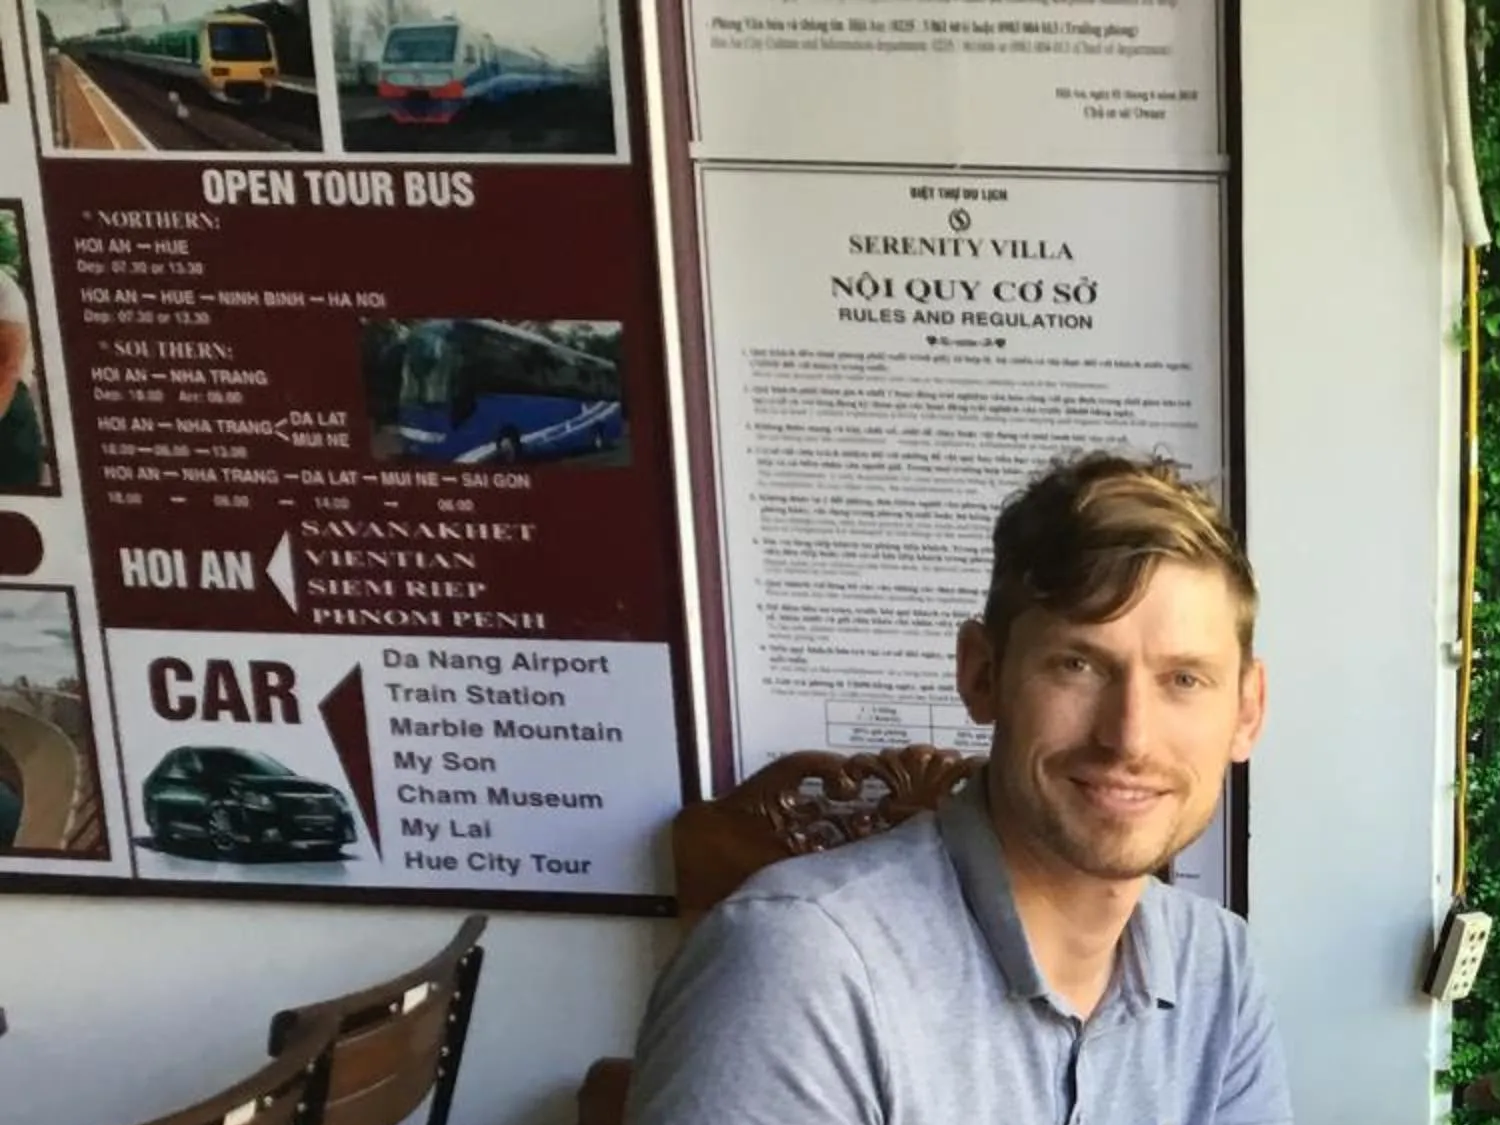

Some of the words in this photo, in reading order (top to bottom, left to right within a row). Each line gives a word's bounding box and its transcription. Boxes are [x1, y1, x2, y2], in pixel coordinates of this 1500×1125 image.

[202, 169, 296, 205] OPEN
[303, 170, 395, 206] TOUR
[405, 171, 475, 207] BUS
[97, 210, 221, 230] NORTHERN:
[75, 238, 103, 253] HOI
[108, 239, 131, 253] AN
[155, 240, 189, 255] HUE
[848, 235, 984, 257] SERENITY
[990, 239, 1074, 261] VILLA
[81, 288, 109, 303] HOI
[115, 289, 138, 304] AN
[161, 290, 195, 305] HUE
[219, 291, 259, 306] NINH
[328, 292, 353, 307] HA
[357, 292, 386, 308] NOI
[830, 271, 893, 301] NỘI
[904, 278, 981, 304] QUY
[993, 279, 1043, 303] CƠ
[1053, 276, 1099, 305] SỞ
[838, 307, 906, 324] RULES
[913, 309, 955, 325] AND
[961, 310, 1093, 329] REGULATION
[91, 367, 120, 382] HOI
[125, 367, 148, 382] AN
[170, 369, 205, 384] NHA
[210, 369, 269, 386] TRANG
[98, 416, 126, 431] HOI
[131, 417, 154, 432] AN
[176, 418, 211, 433] NHA
[216, 419, 274, 435] TRANG
[290, 410, 314, 425] DA
[318, 411, 347, 425] LAT
[327, 433, 349, 448] NE
[104, 466, 133, 480] HOI
[138, 466, 160, 480] AN
[182, 467, 217, 482] NHA
[222, 469, 279, 485] TRANG
[302, 470, 326, 485] DA
[329, 470, 357, 485] LAT
[381, 471, 412, 486] MUI
[416, 472, 439, 487] NE
[462, 472, 488, 488] SAI
[493, 473, 531, 489] GON
[301, 519, 537, 541] SAVANAKHET
[119, 547, 188, 589] HOI
[200, 549, 256, 591] AN
[305, 549, 476, 569] VIENTIAN
[307, 579, 394, 596] SIEM
[405, 580, 487, 598] RIEP
[312, 607, 442, 627] PHNOM
[453, 611, 546, 629] PENH
[382, 648, 418, 669] Da
[428, 650, 502, 675] Nang
[512, 652, 610, 676] Airport
[148, 656, 303, 724] CAR
[385, 683, 456, 703] Train
[466, 685, 565, 707] Station
[390, 717, 484, 738] Marble
[493, 720, 623, 742] Mountain
[393, 751, 433, 774] My
[442, 752, 496, 772] Son
[397, 784, 477, 805] Cham
[487, 787, 603, 809] Museum
[401, 818, 440, 841] My
[450, 819, 492, 839] Lai
[404, 851, 459, 872] Hue
[467, 852, 522, 876] City
[531, 854, 592, 875] Tour
